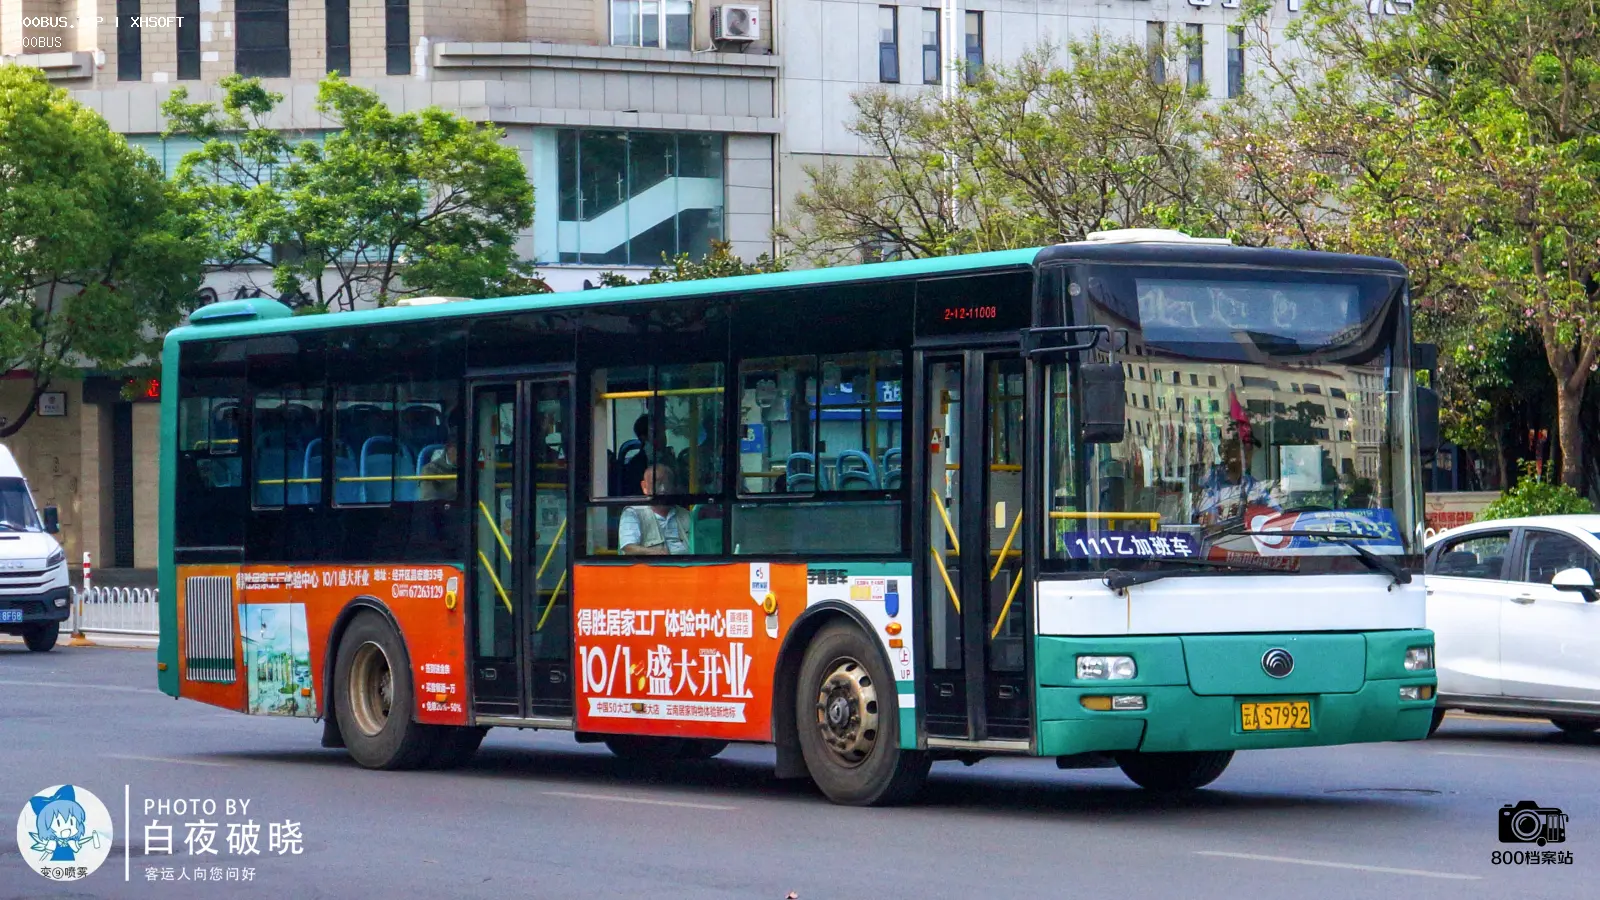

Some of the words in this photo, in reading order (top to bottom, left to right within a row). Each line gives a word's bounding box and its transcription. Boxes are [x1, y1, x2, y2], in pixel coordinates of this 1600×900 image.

[409, 585, 443, 599] 67263129
[577, 608, 726, 638] 得胜居家工厂体验中心
[900, 668, 911, 680] UP
